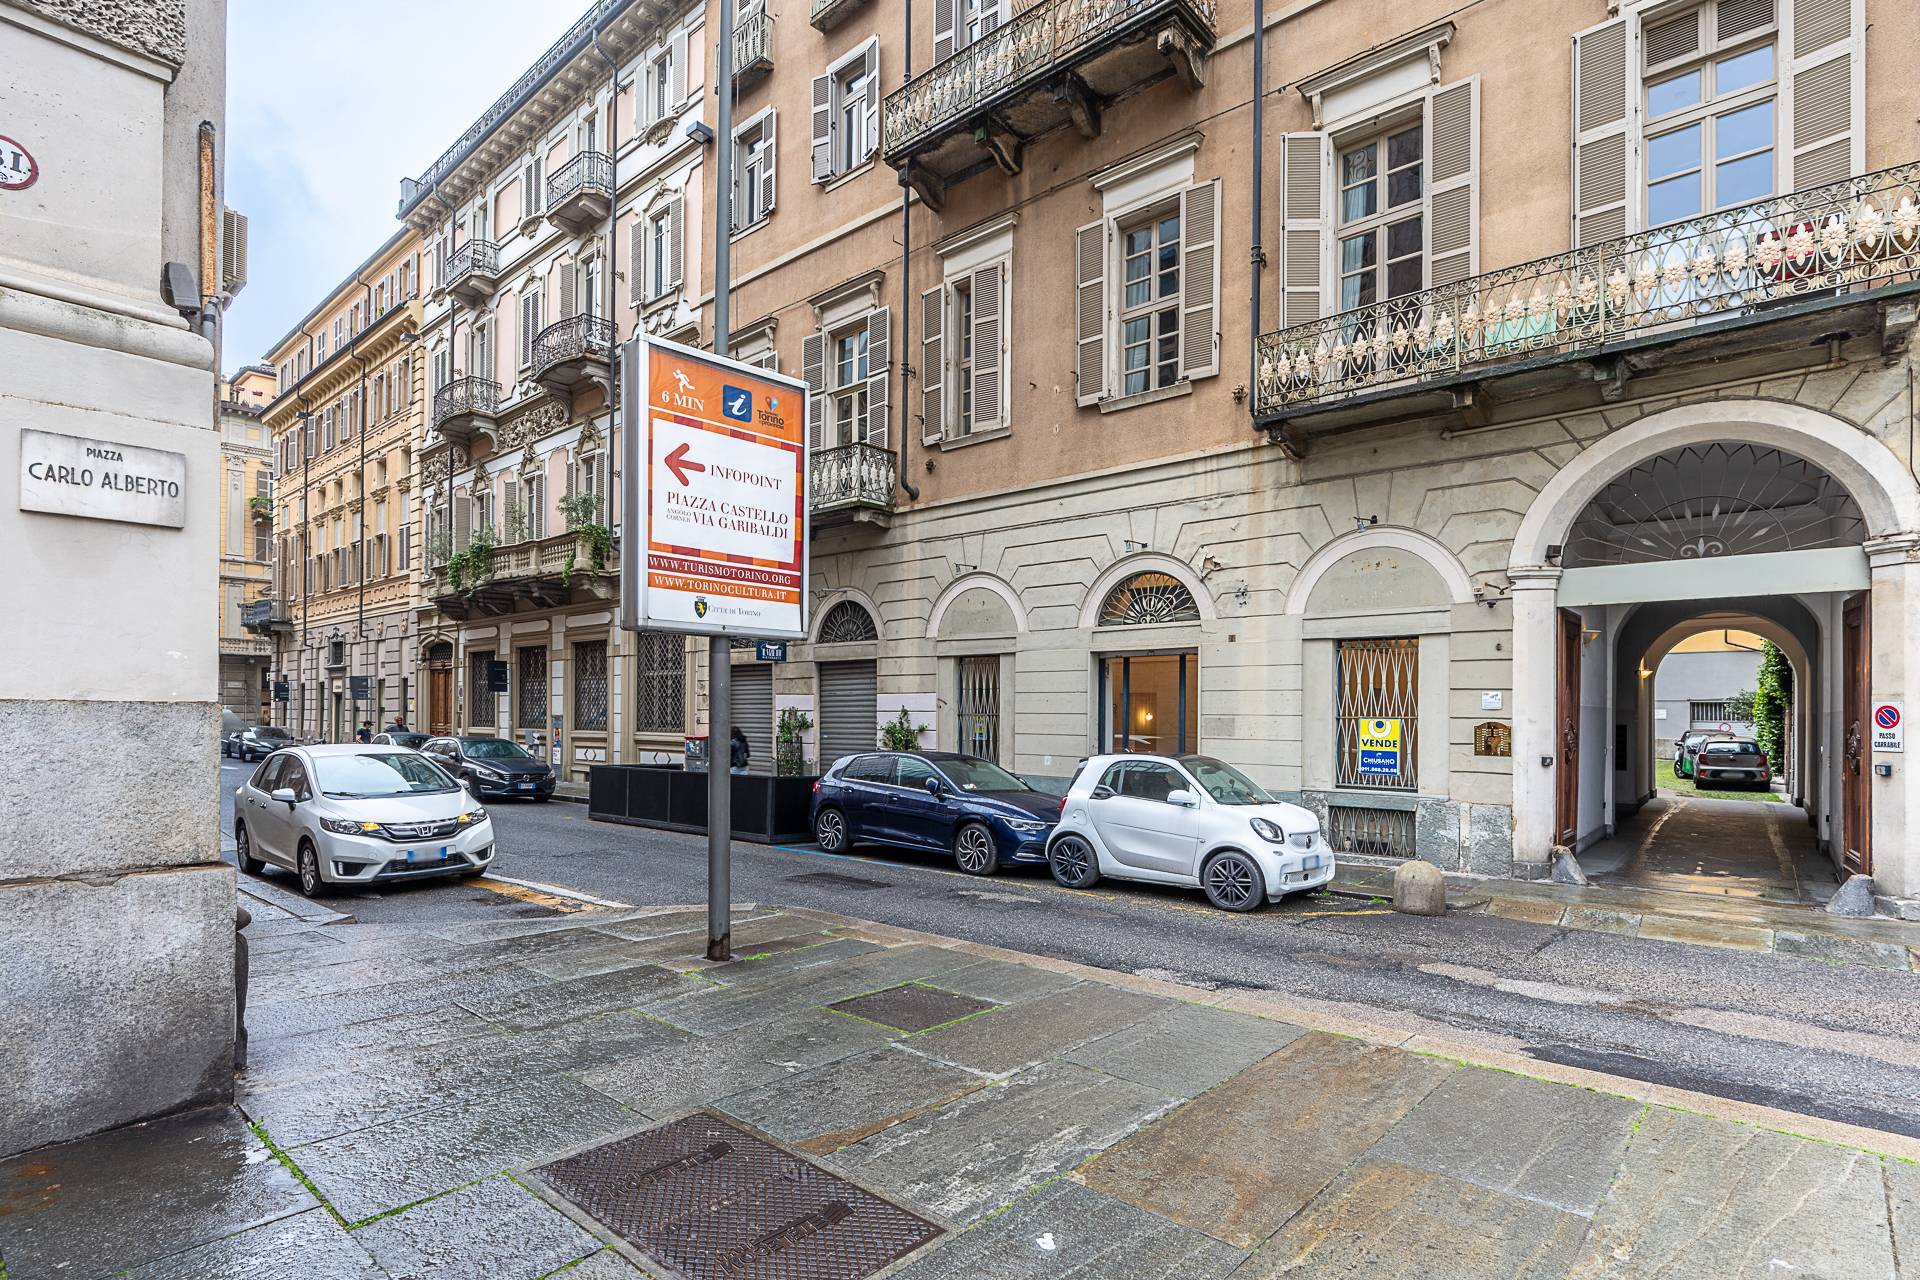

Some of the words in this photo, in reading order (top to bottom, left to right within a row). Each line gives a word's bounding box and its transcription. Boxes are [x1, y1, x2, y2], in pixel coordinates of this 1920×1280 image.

[661, 390, 670, 403] 6
[673, 392, 705, 412] MIN
[757, 409, 785, 425] Torino
[86, 447, 124, 462] PIAZZA
[28, 462, 94, 487] CARLO
[101, 472, 179, 498] ALBERTO
[710, 464, 782, 490] INFOPOINT
[667, 491, 716, 512] PIAZZA
[720, 502, 788, 525] CASTELLO
[693, 511, 714, 527] VIA
[718, 516, 788, 539] GARIBALDI
[649, 556, 791, 585] WWW.TURISMOTORINO.ORG
[654, 575, 787, 600] WWW.TORINOCULTURA.IT
[1361, 738, 1398, 748] VENDE
[1874, 741, 1901, 749] CARRABILE
[1879, 732, 1896, 740] PASSO
